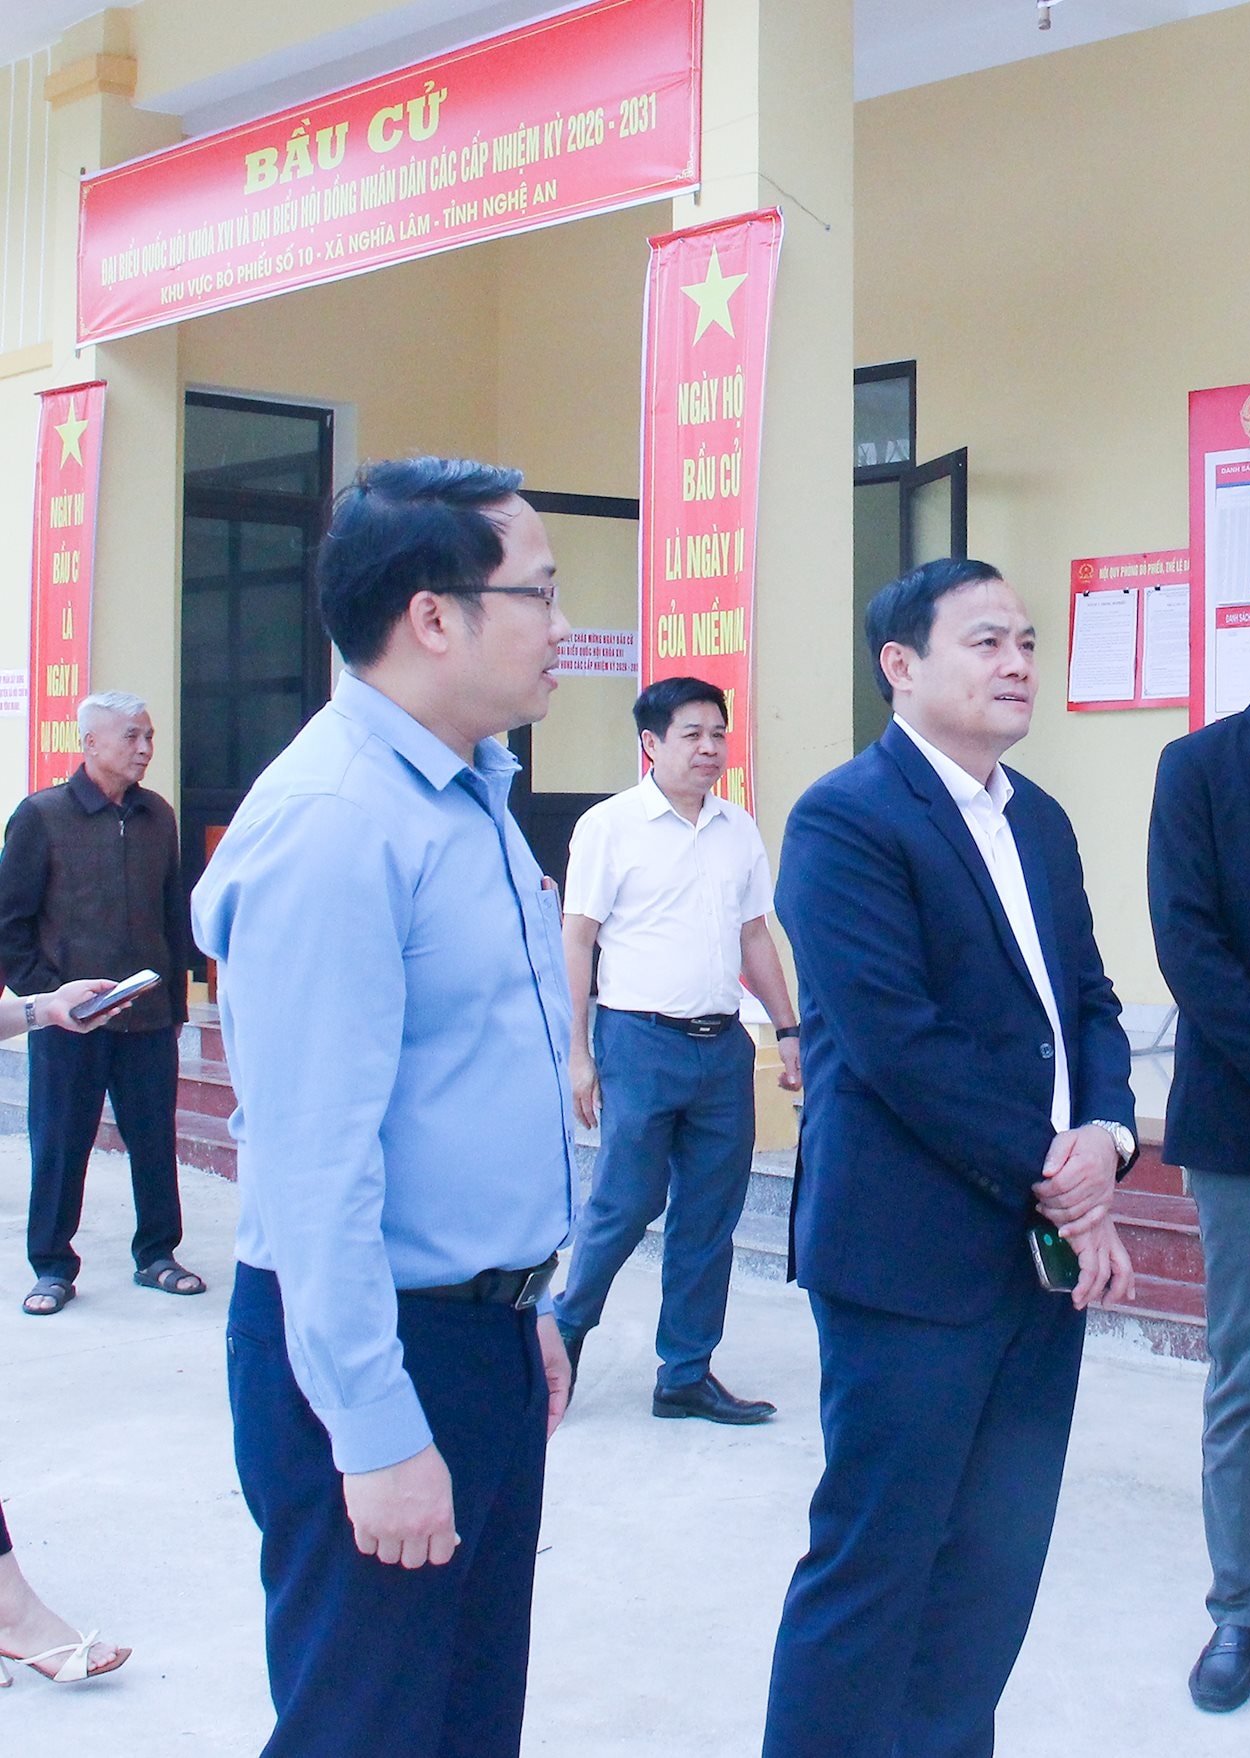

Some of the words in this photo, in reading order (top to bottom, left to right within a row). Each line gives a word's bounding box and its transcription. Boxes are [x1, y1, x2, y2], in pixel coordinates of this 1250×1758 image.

[244, 118, 349, 195] BẦU
[367, 80, 448, 153] CỬ
[102, 255, 116, 291] ĐẠI
[119, 238, 139, 281] BIỂU
[142, 232, 167, 277] QUỐC
[170, 229, 185, 271] HỘI
[189, 221, 215, 261] KHÓA
[217, 219, 233, 253] XVI
[237, 208, 250, 246] VÀ
[253, 208, 269, 247] ĐẠI
[273, 189, 297, 237] BIỂU
[301, 186, 320, 233] HỘI
[324, 174, 356, 222] ĐỒNG
[361, 164, 396, 211] NHÂN
[400, 156, 426, 200] DÂN
[431, 146, 456, 191] CÁC
[461, 130, 488, 183] CẤP
[493, 122, 539, 174] NHIỆM
[544, 112, 563, 159] KỲ
[567, 107, 604, 153] 2026
[620, 92, 656, 138] 2031
[161, 282, 184, 305] KHU
[188, 275, 212, 300] VỰC
[216, 262, 233, 290] BỎ
[237, 251, 272, 284] PHIẾU
[276, 243, 294, 274] SỐ
[299, 247, 313, 267] 10
[325, 234, 344, 260] XÃ
[349, 221, 395, 254] NGHĨA
[400, 212, 430, 241] LÂM
[443, 200, 477, 228] TỈNH
[483, 182, 528, 218] NGHỆ
[533, 179, 557, 205] AN
[678, 370, 719, 426] NGÀY
[682, 441, 716, 501] BẦU
[665, 527, 682, 581] LÀ
[686, 523, 730, 579] NGÀY
[657, 598, 686, 659] CỦA
